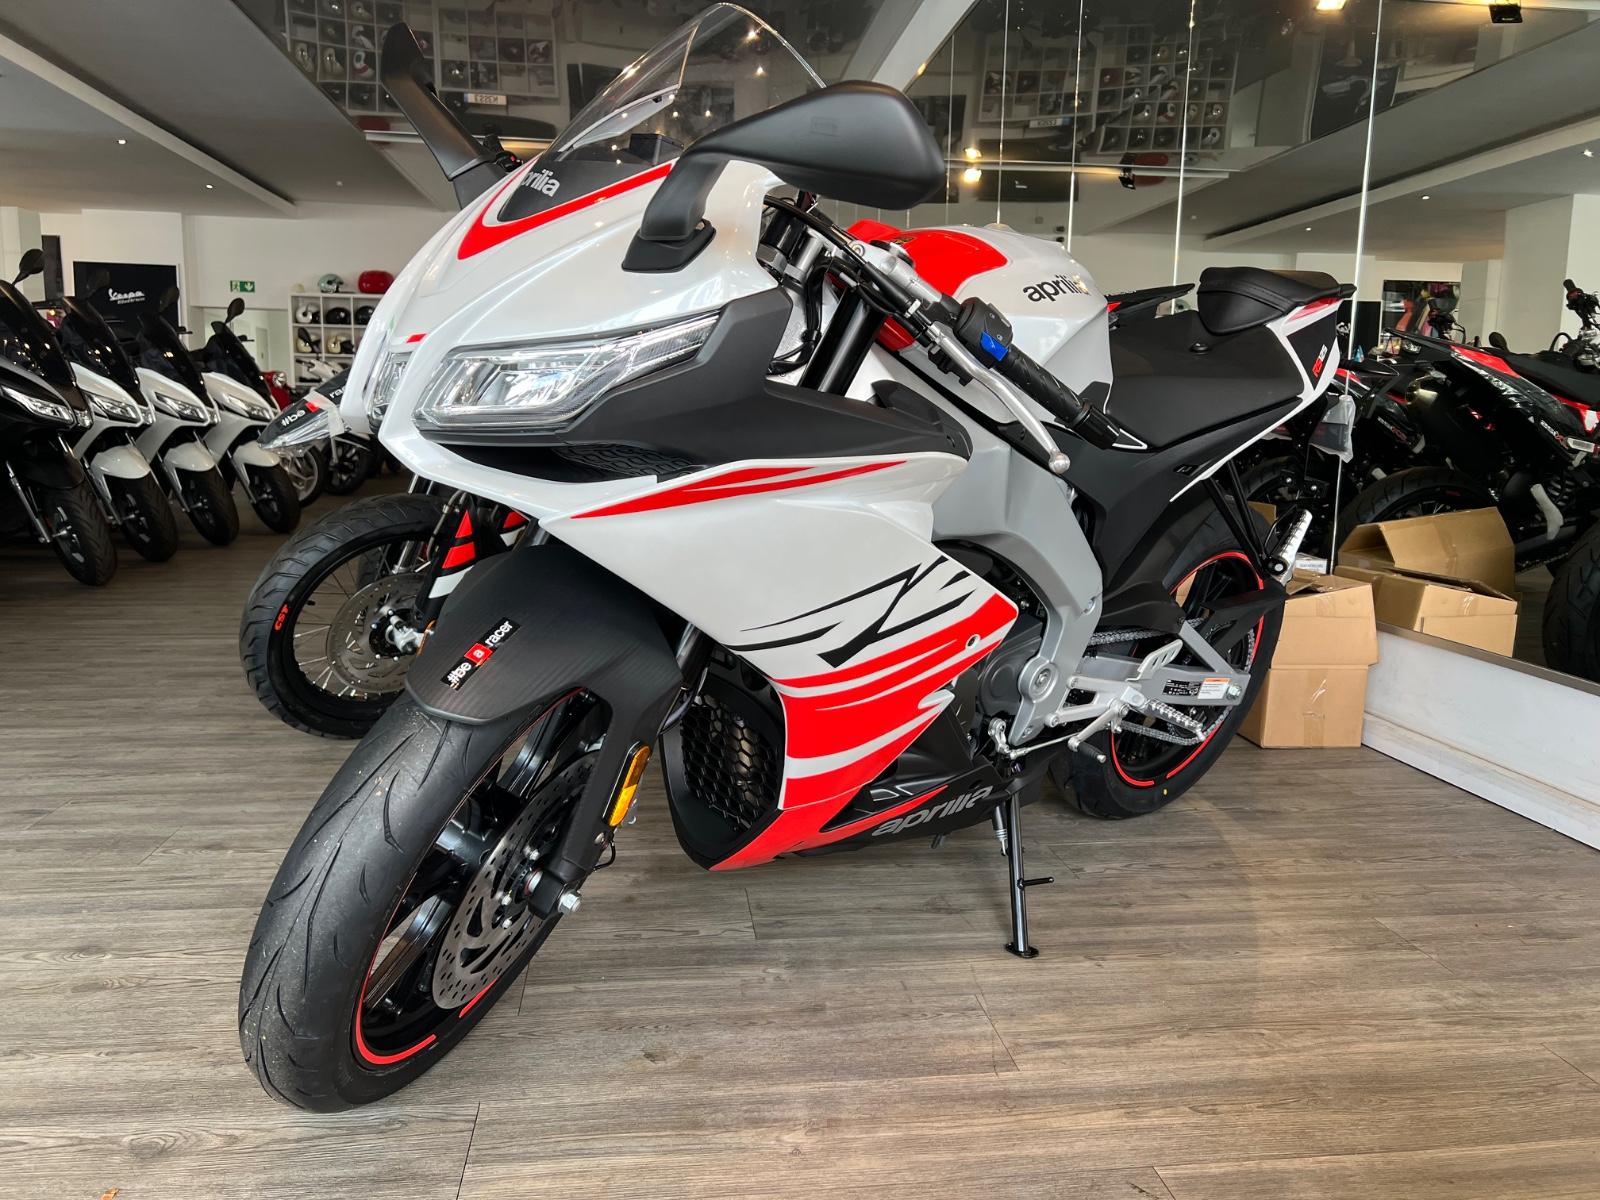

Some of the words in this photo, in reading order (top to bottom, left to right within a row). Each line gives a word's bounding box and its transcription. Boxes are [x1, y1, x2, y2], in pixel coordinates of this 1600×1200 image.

[274, 603, 289, 631] CST
[446, 662, 472, 684] #be
[473, 649, 485, 658] a
[484, 620, 513, 647] racer
[871, 785, 994, 837] aprilia
